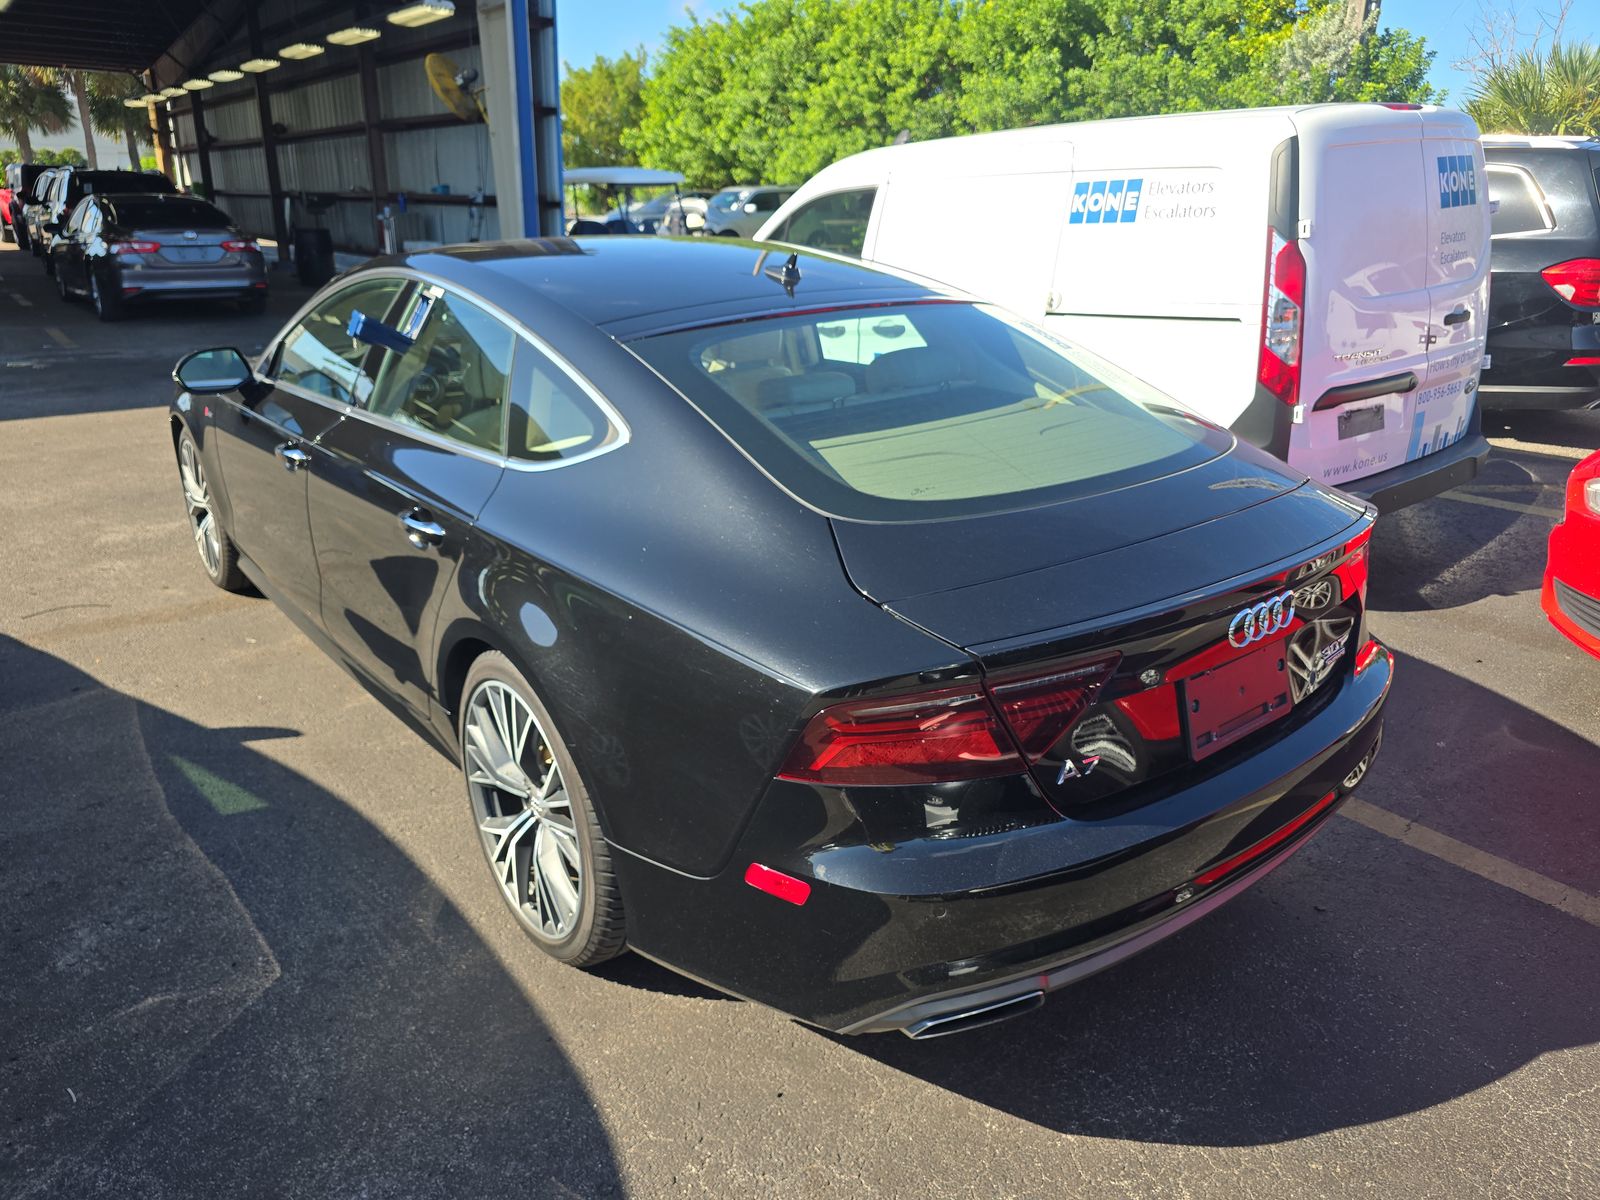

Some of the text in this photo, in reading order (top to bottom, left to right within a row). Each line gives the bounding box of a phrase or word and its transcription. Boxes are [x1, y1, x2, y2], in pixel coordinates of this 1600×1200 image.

[1149, 181, 1215, 196] Elevators
[1440, 170, 1475, 193] KONE
[1070, 190, 1140, 213] KONE
[1144, 203, 1217, 220] Escalators
[1323, 451, 1388, 478] www.kone.us
[1056, 755, 1101, 785] A7
